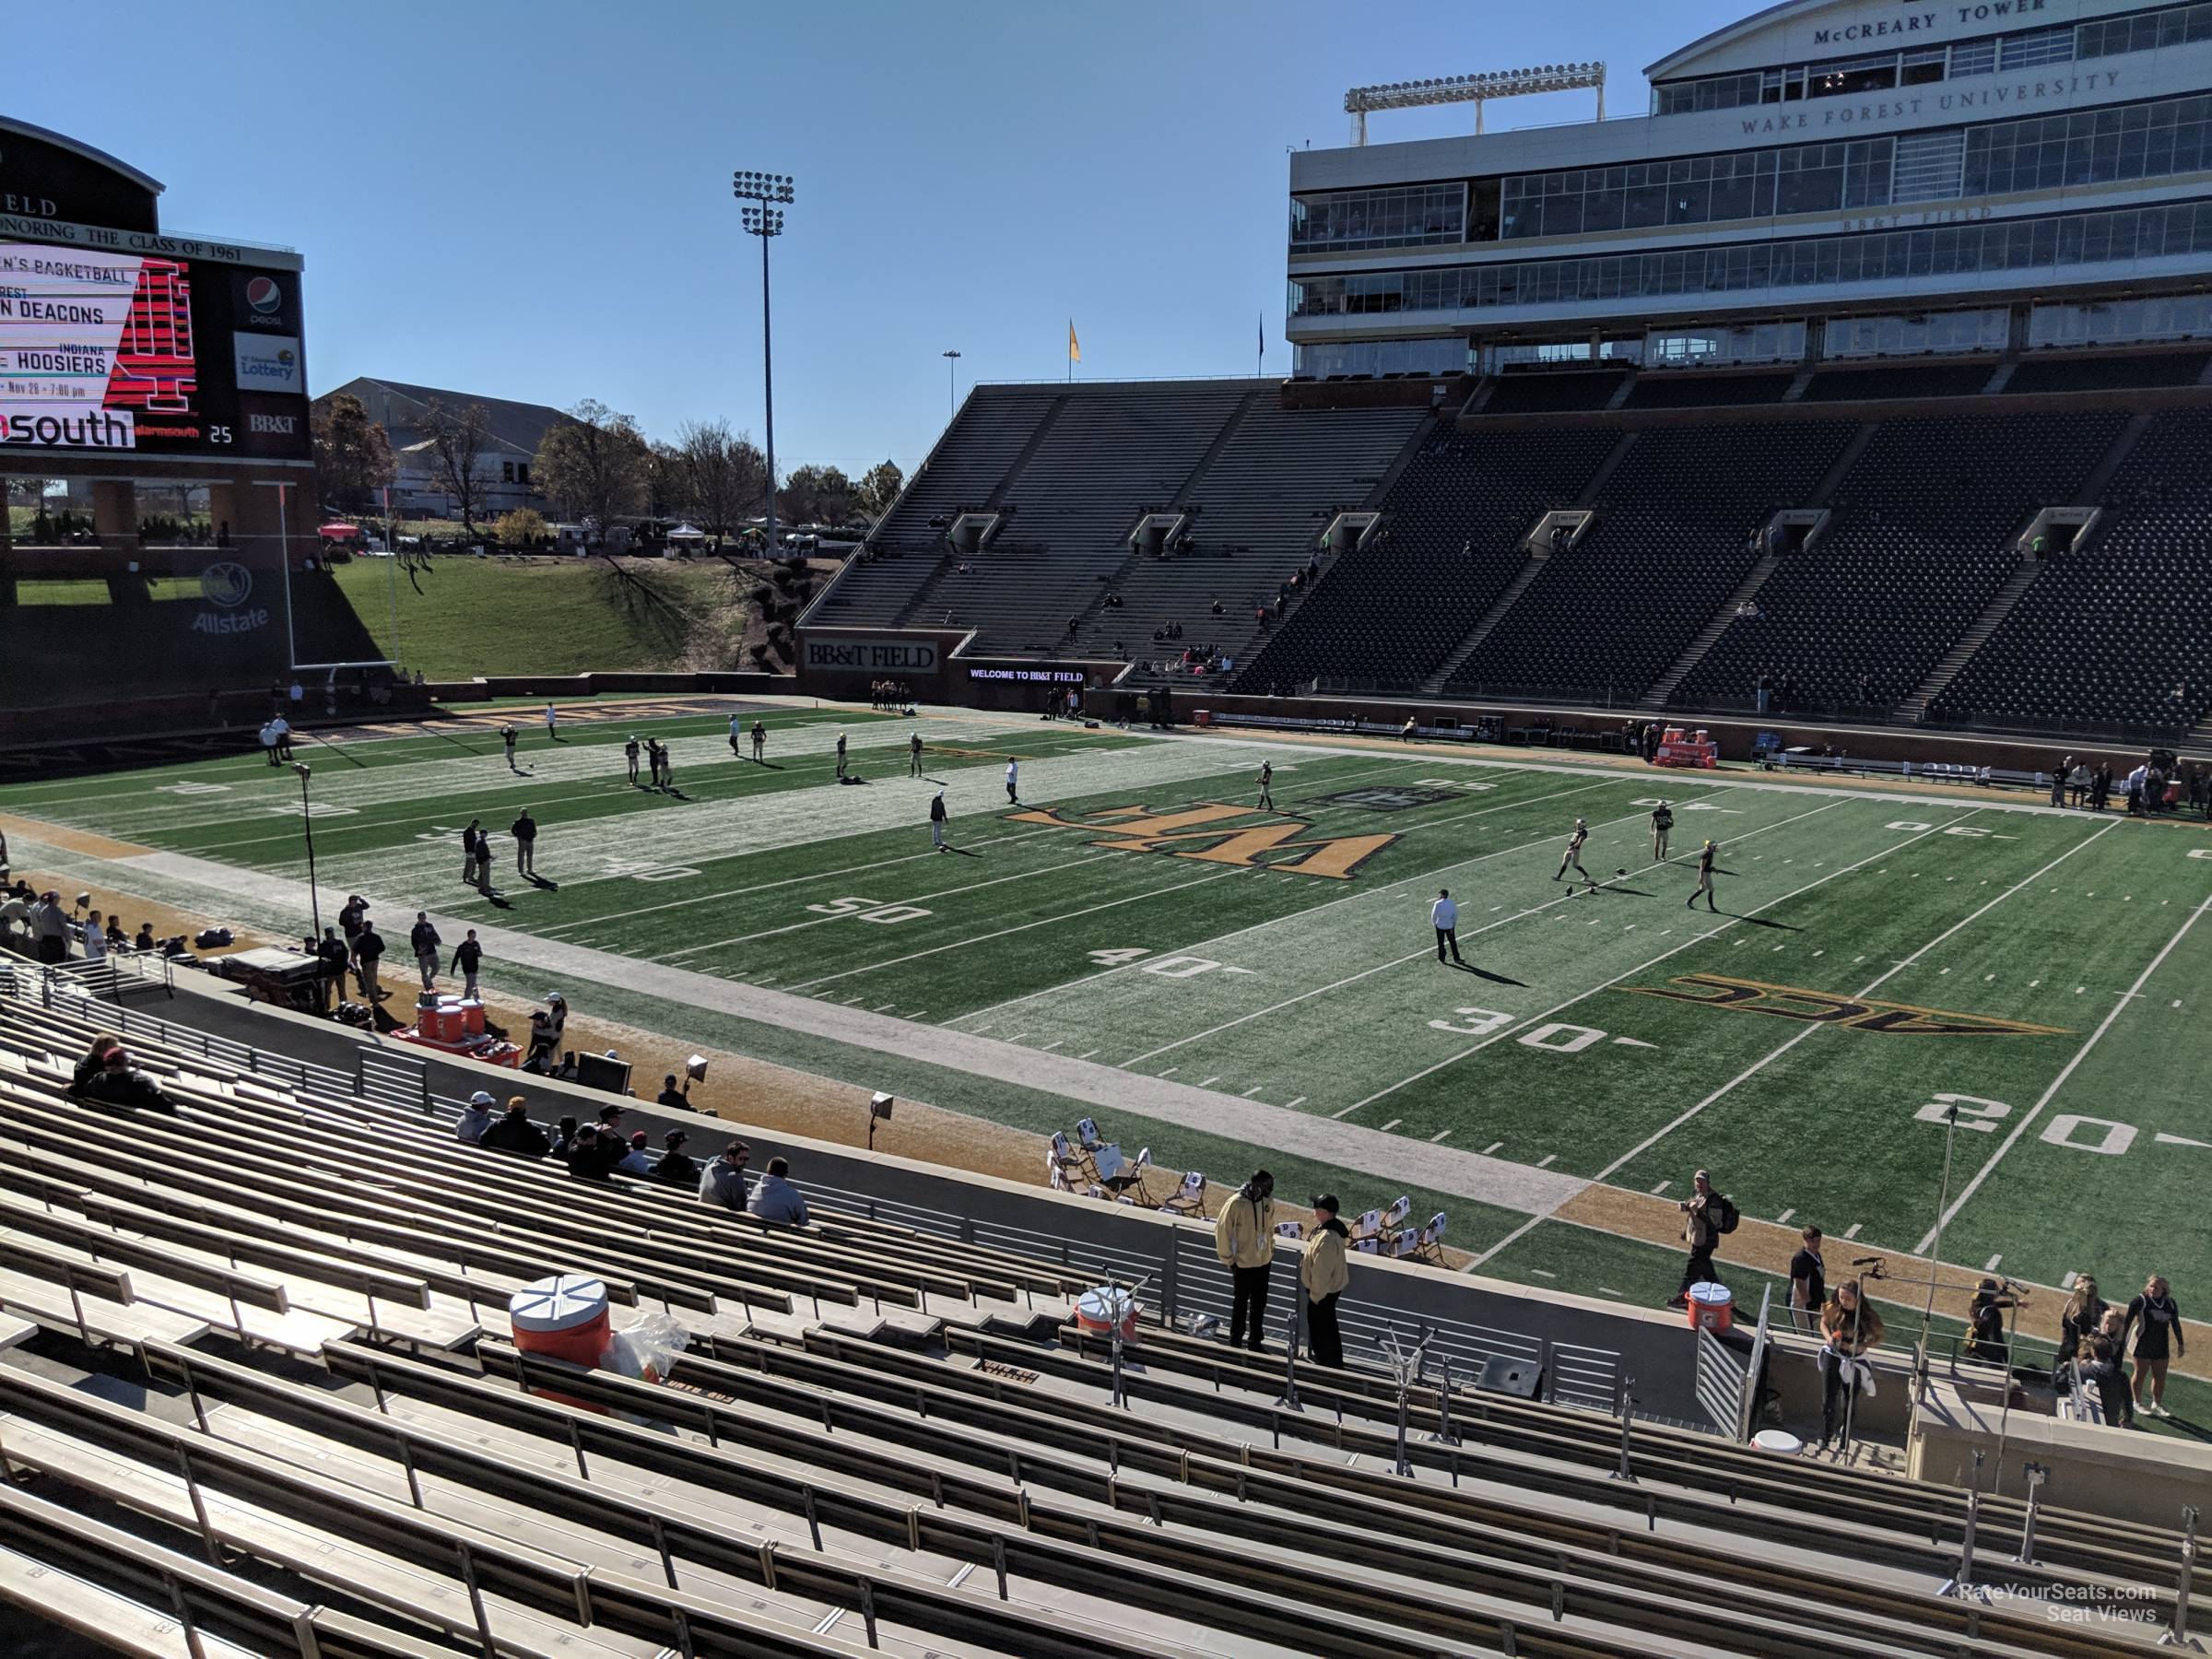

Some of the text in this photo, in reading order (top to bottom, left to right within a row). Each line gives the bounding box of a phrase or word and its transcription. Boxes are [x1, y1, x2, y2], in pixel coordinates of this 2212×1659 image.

[1814, 0, 2045, 44] McCREARY TOWER
[1742, 71, 2119, 134] WAKE FOREST UNIVERSITY
[1843, 207, 1992, 231] BB&T FIELD
[88, 228, 120, 245] THE
[129, 235, 175, 252] CLASS
[182, 241, 203, 255] OF
[209, 245, 241, 261] 1961
[34, 259, 128, 283] BASKETBALL
[19, 300, 103, 324] DEACONS
[59, 343, 105, 357] INDIANA
[18, 352, 106, 374] HOOSIERS
[241, 361, 293, 381] Lottery
[8, 382, 25, 394] Nov
[0, 410, 128, 446] south
[211, 426, 232, 443] 25
[251, 414, 297, 434] BB&T
[192, 608, 269, 635] Allstate
[809, 644, 935, 668] BB&T FIELD
[971, 668, 1083, 682] WELCOME TO BB&T FIELD
[806, 896, 934, 924] 50
[1087, 947, 1222, 978] 40
[1426, 1006, 1609, 1053] 30
[1912, 1092, 2140, 1156] 20
